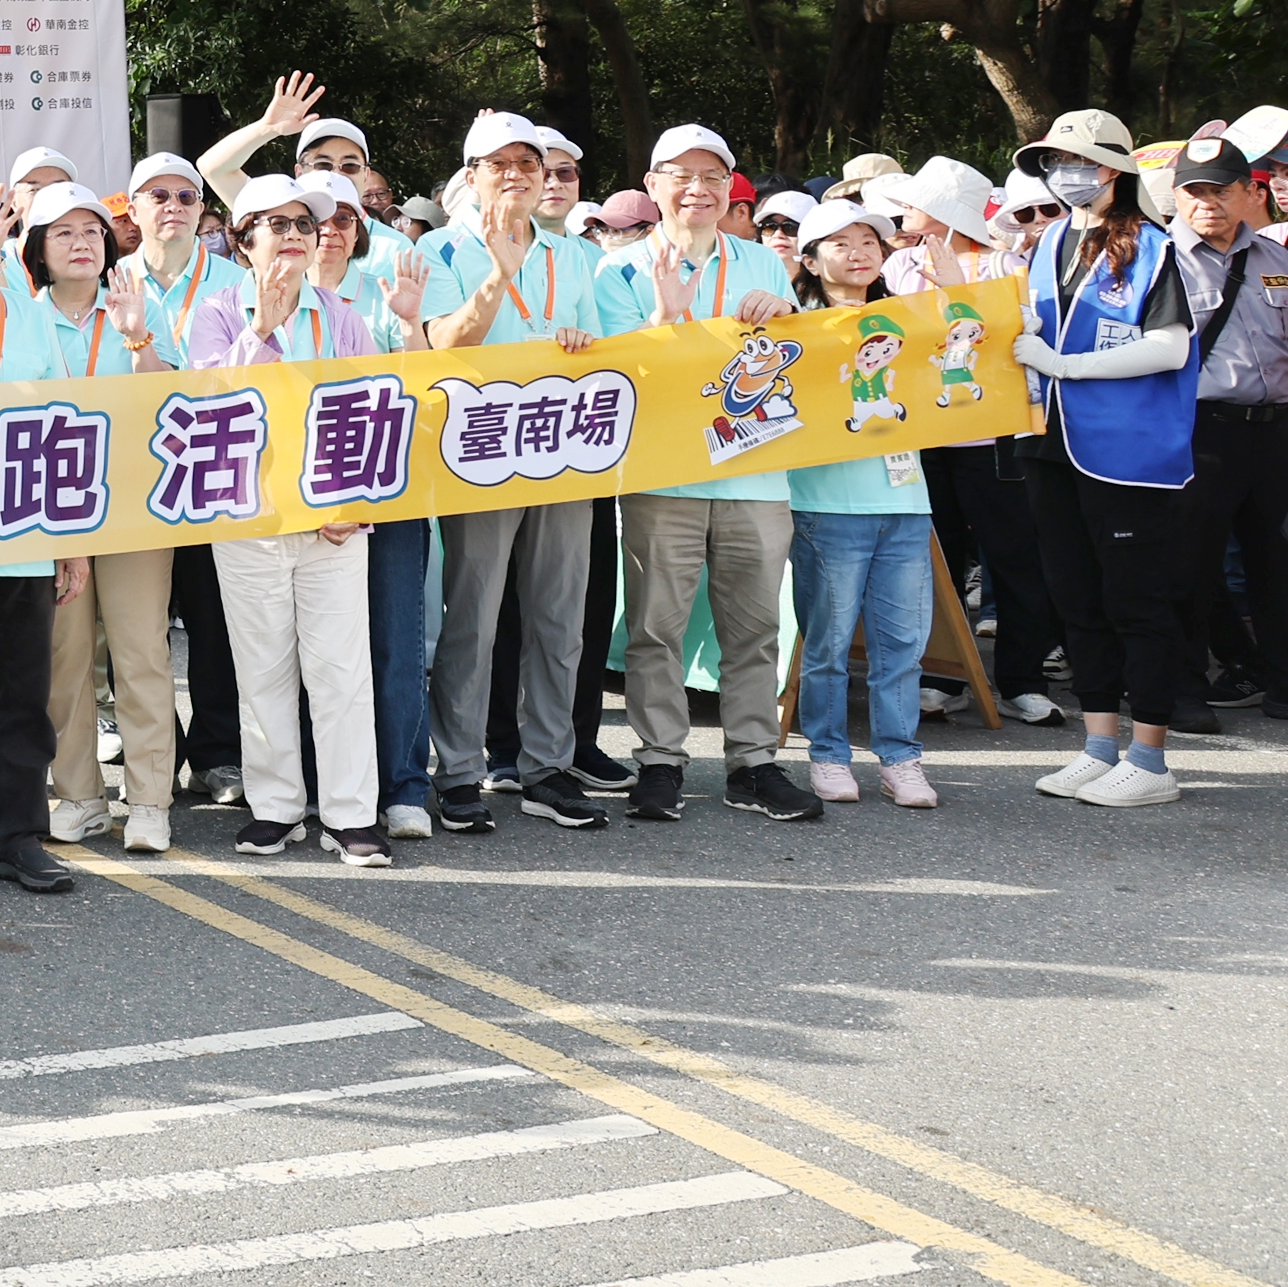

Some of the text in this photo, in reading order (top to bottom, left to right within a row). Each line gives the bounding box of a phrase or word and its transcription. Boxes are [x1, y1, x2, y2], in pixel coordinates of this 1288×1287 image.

[45, 19, 89, 31] 華南金控
[15, 45, 60, 56] 彰化銀行
[47, 71, 92, 83] 合庫票券
[47, 97, 92, 109] 合庫投信
[457, 387, 622, 464] 臺南場
